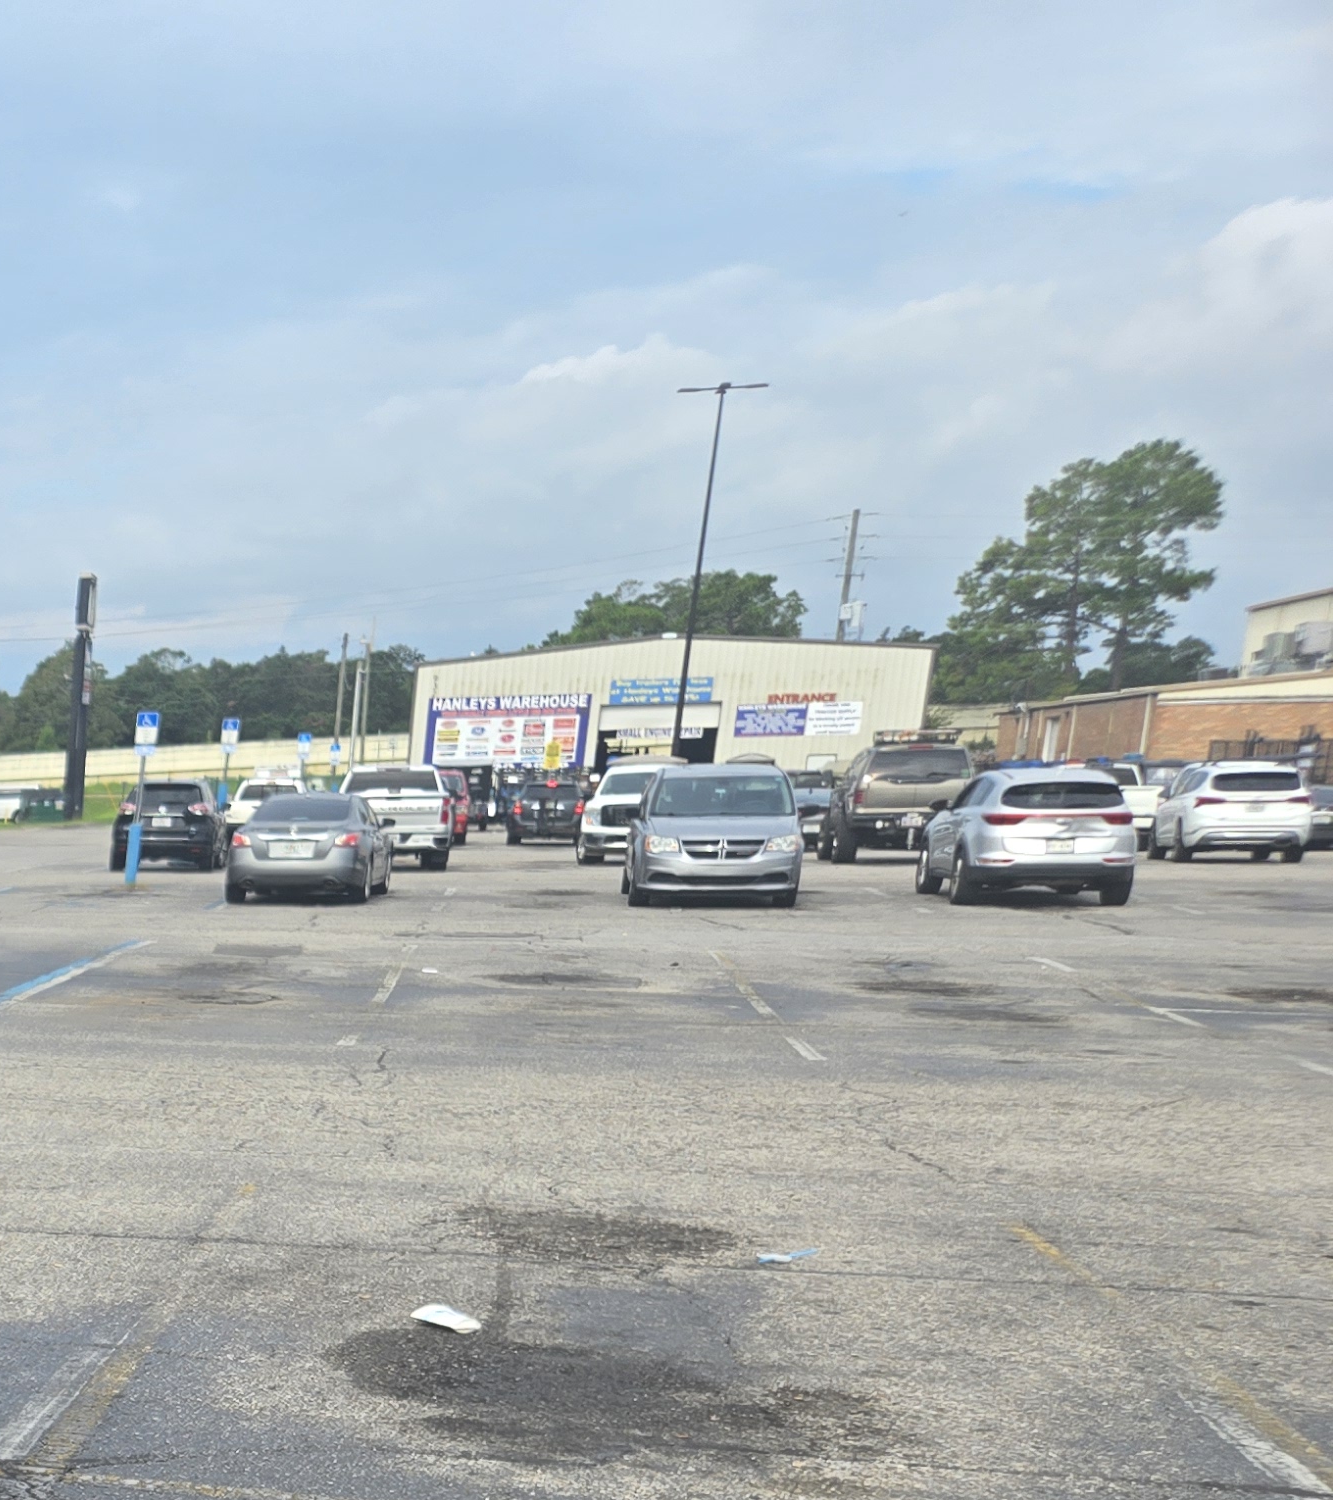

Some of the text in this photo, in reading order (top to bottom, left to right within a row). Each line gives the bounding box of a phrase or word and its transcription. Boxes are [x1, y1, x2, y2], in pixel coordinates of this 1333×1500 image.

[433, 694, 589, 711] HANLEYS WAREHOUSE
[768, 693, 837, 704] ENTRANCE
